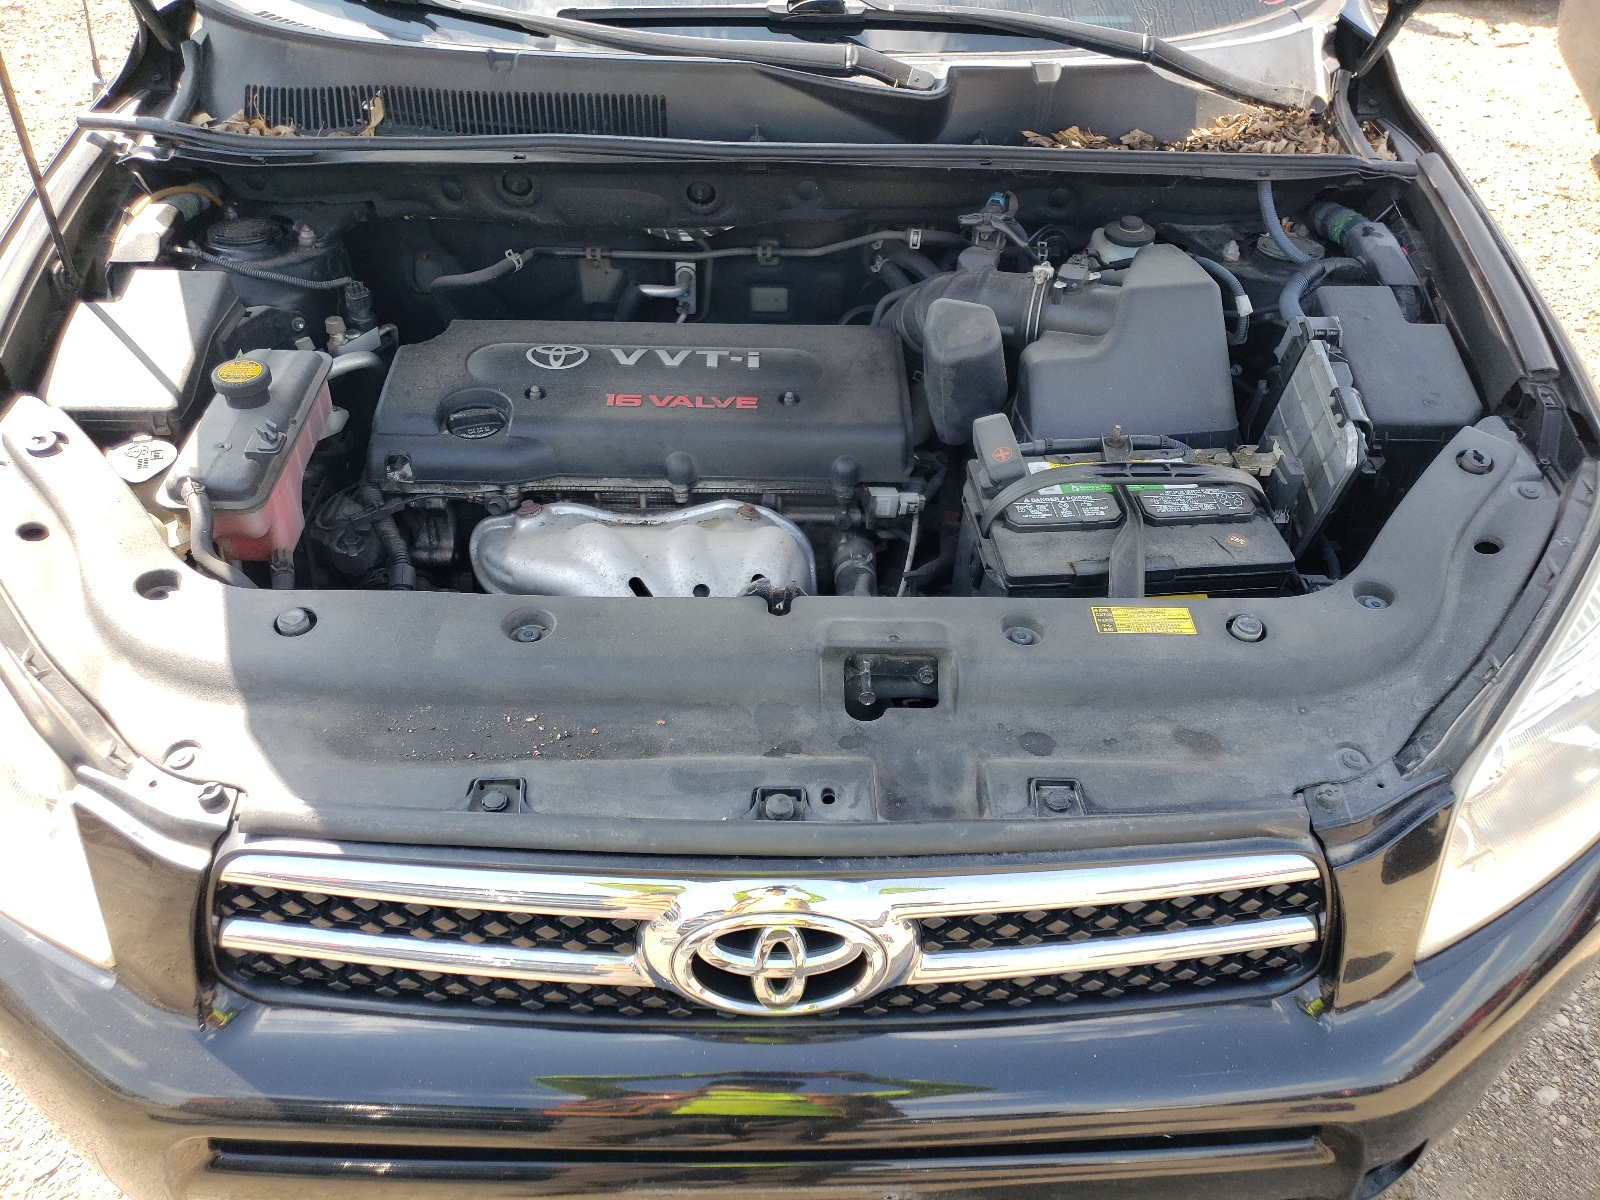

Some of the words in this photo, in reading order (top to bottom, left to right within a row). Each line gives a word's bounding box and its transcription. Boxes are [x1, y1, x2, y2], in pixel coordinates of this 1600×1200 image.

[609, 348, 760, 368] VVT-i
[604, 393, 643, 407] 16
[648, 394, 759, 409] VALVE
